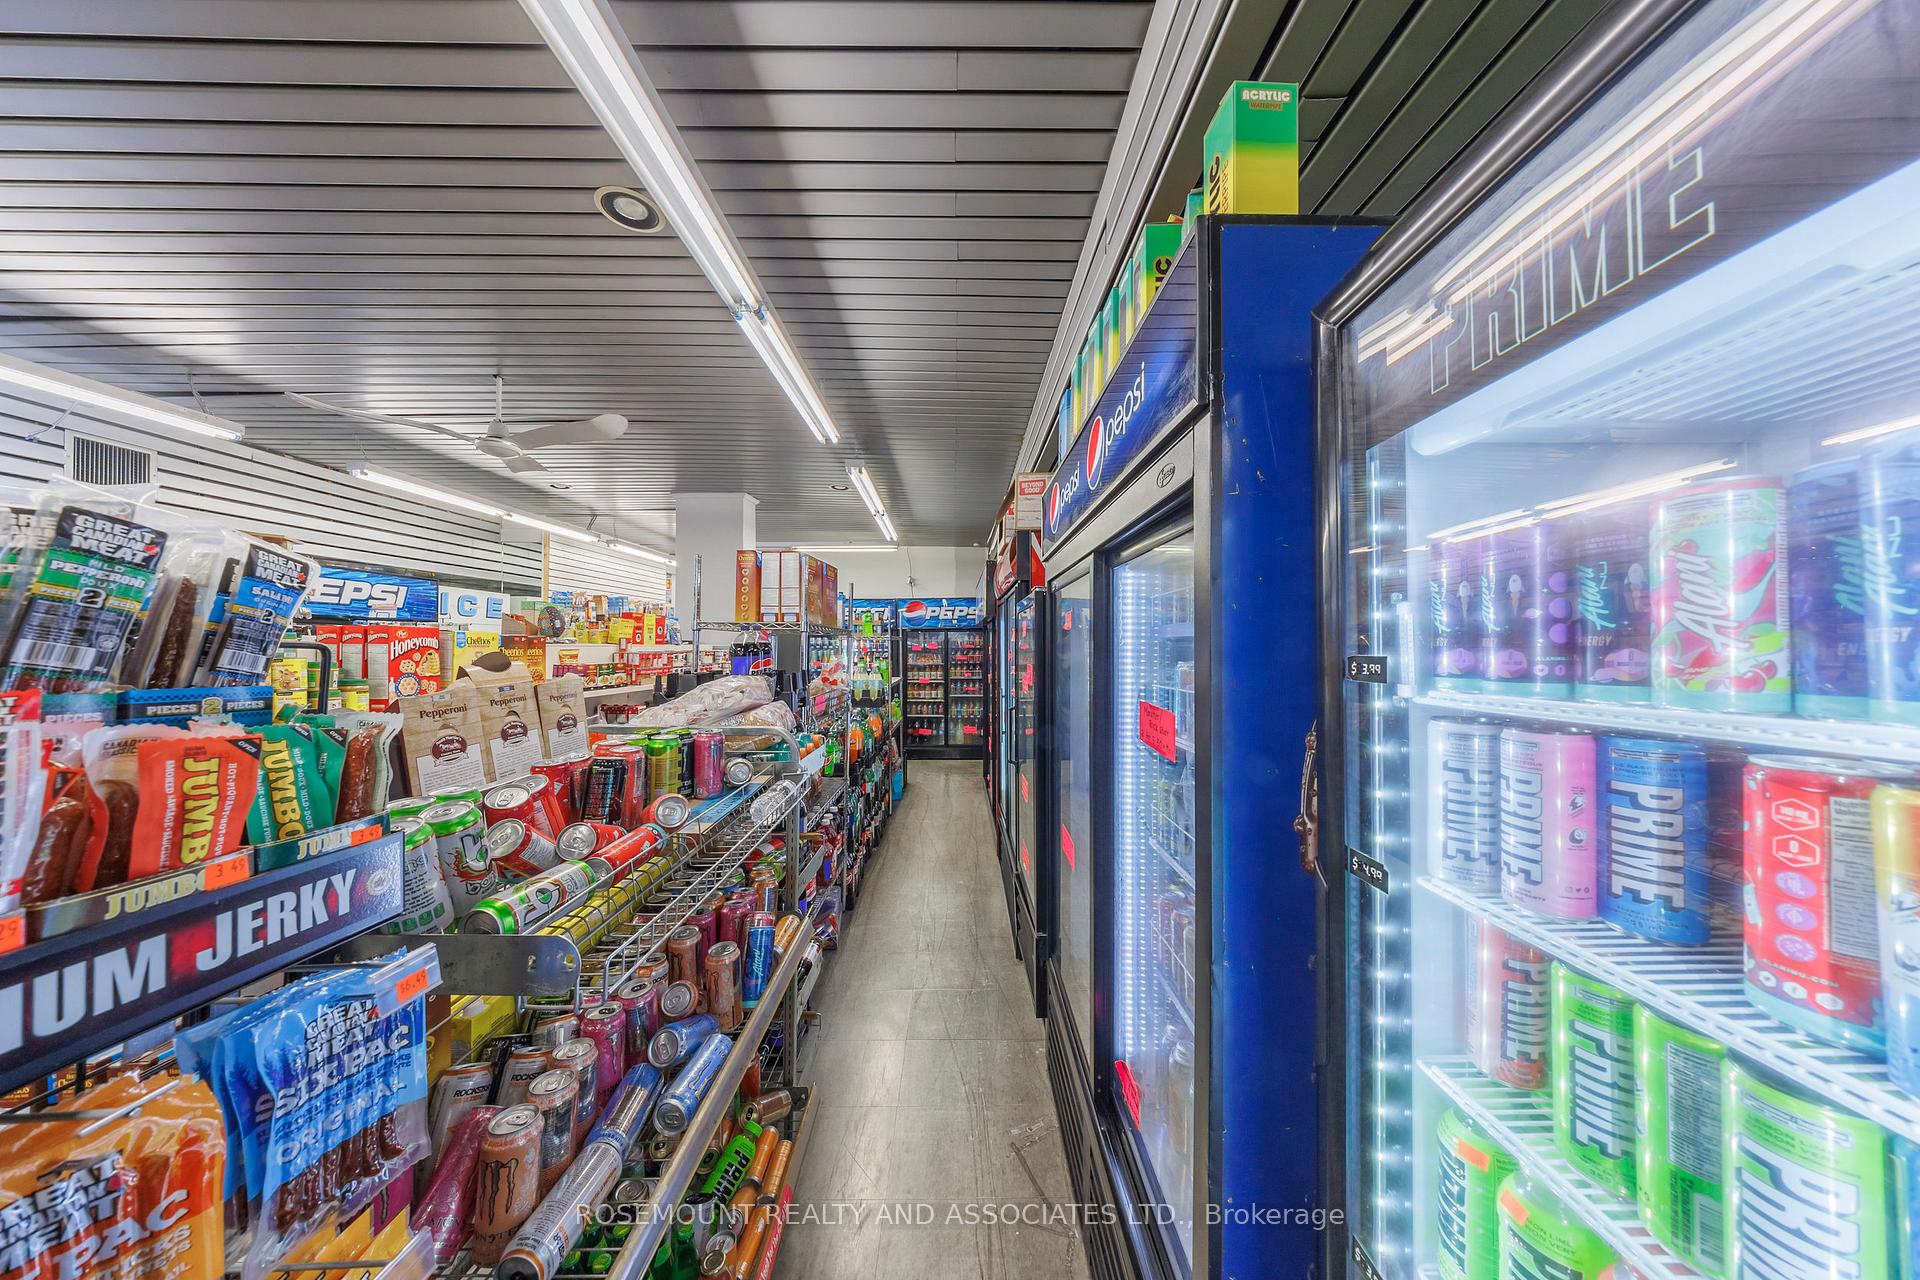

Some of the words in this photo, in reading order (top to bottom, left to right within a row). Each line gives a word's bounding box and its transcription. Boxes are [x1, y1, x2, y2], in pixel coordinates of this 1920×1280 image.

[1242, 90, 1291, 102] ACRYLIC
[1430, 132, 1716, 395] PRIME
[1106, 362, 1145, 457] pepsi
[1021, 481, 1045, 489] BEYOND
[1060, 461, 1080, 510] pepsi
[71, 513, 156, 544] GREAT
[71, 526, 147, 552] CANADIAN
[69, 535, 150, 565] MEAT
[257, 549, 304, 572] GREAT
[50, 559, 147, 589] PEPPERONI
[255, 567, 302, 586] MEAT
[76, 587, 107, 609] 2
[316, 576, 409, 609] EPSI
[440, 590, 504, 619] ICE
[1668, 550, 1752, 653] Alani
[260, 607, 276, 625] 2
[926, 606, 980, 620] PEPS
[390, 636, 440, 661] Honeycomb
[466, 635, 492, 646] Cheerios
[527, 646, 543, 656] eerios
[1351, 660, 1358, 676] $
[1361, 662, 1382, 676] 3.99
[146, 703, 198, 716] PIECES
[200, 696, 224, 715] 2
[490, 695, 527, 708] Pepperoni
[550, 692, 578, 703] Pepperoni
[419, 703, 468, 720] Pepperoni
[237, 740, 258, 754] OPEN
[329, 730, 344, 742] OPEN
[261, 740, 306, 841] JUMBO
[180, 757, 221, 865] JUMB
[1608, 780, 1685, 912] PRIME
[1352, 855, 1359, 870] $
[196, 867, 358, 972] JERKY
[1503, 958, 1548, 1063] PRIME
[342, 1024, 411, 1079] PAC
[1570, 1019, 1637, 1160] PRIME
[0, 1150, 124, 1217] REAT
[711, 1147, 752, 1210] PRIM
